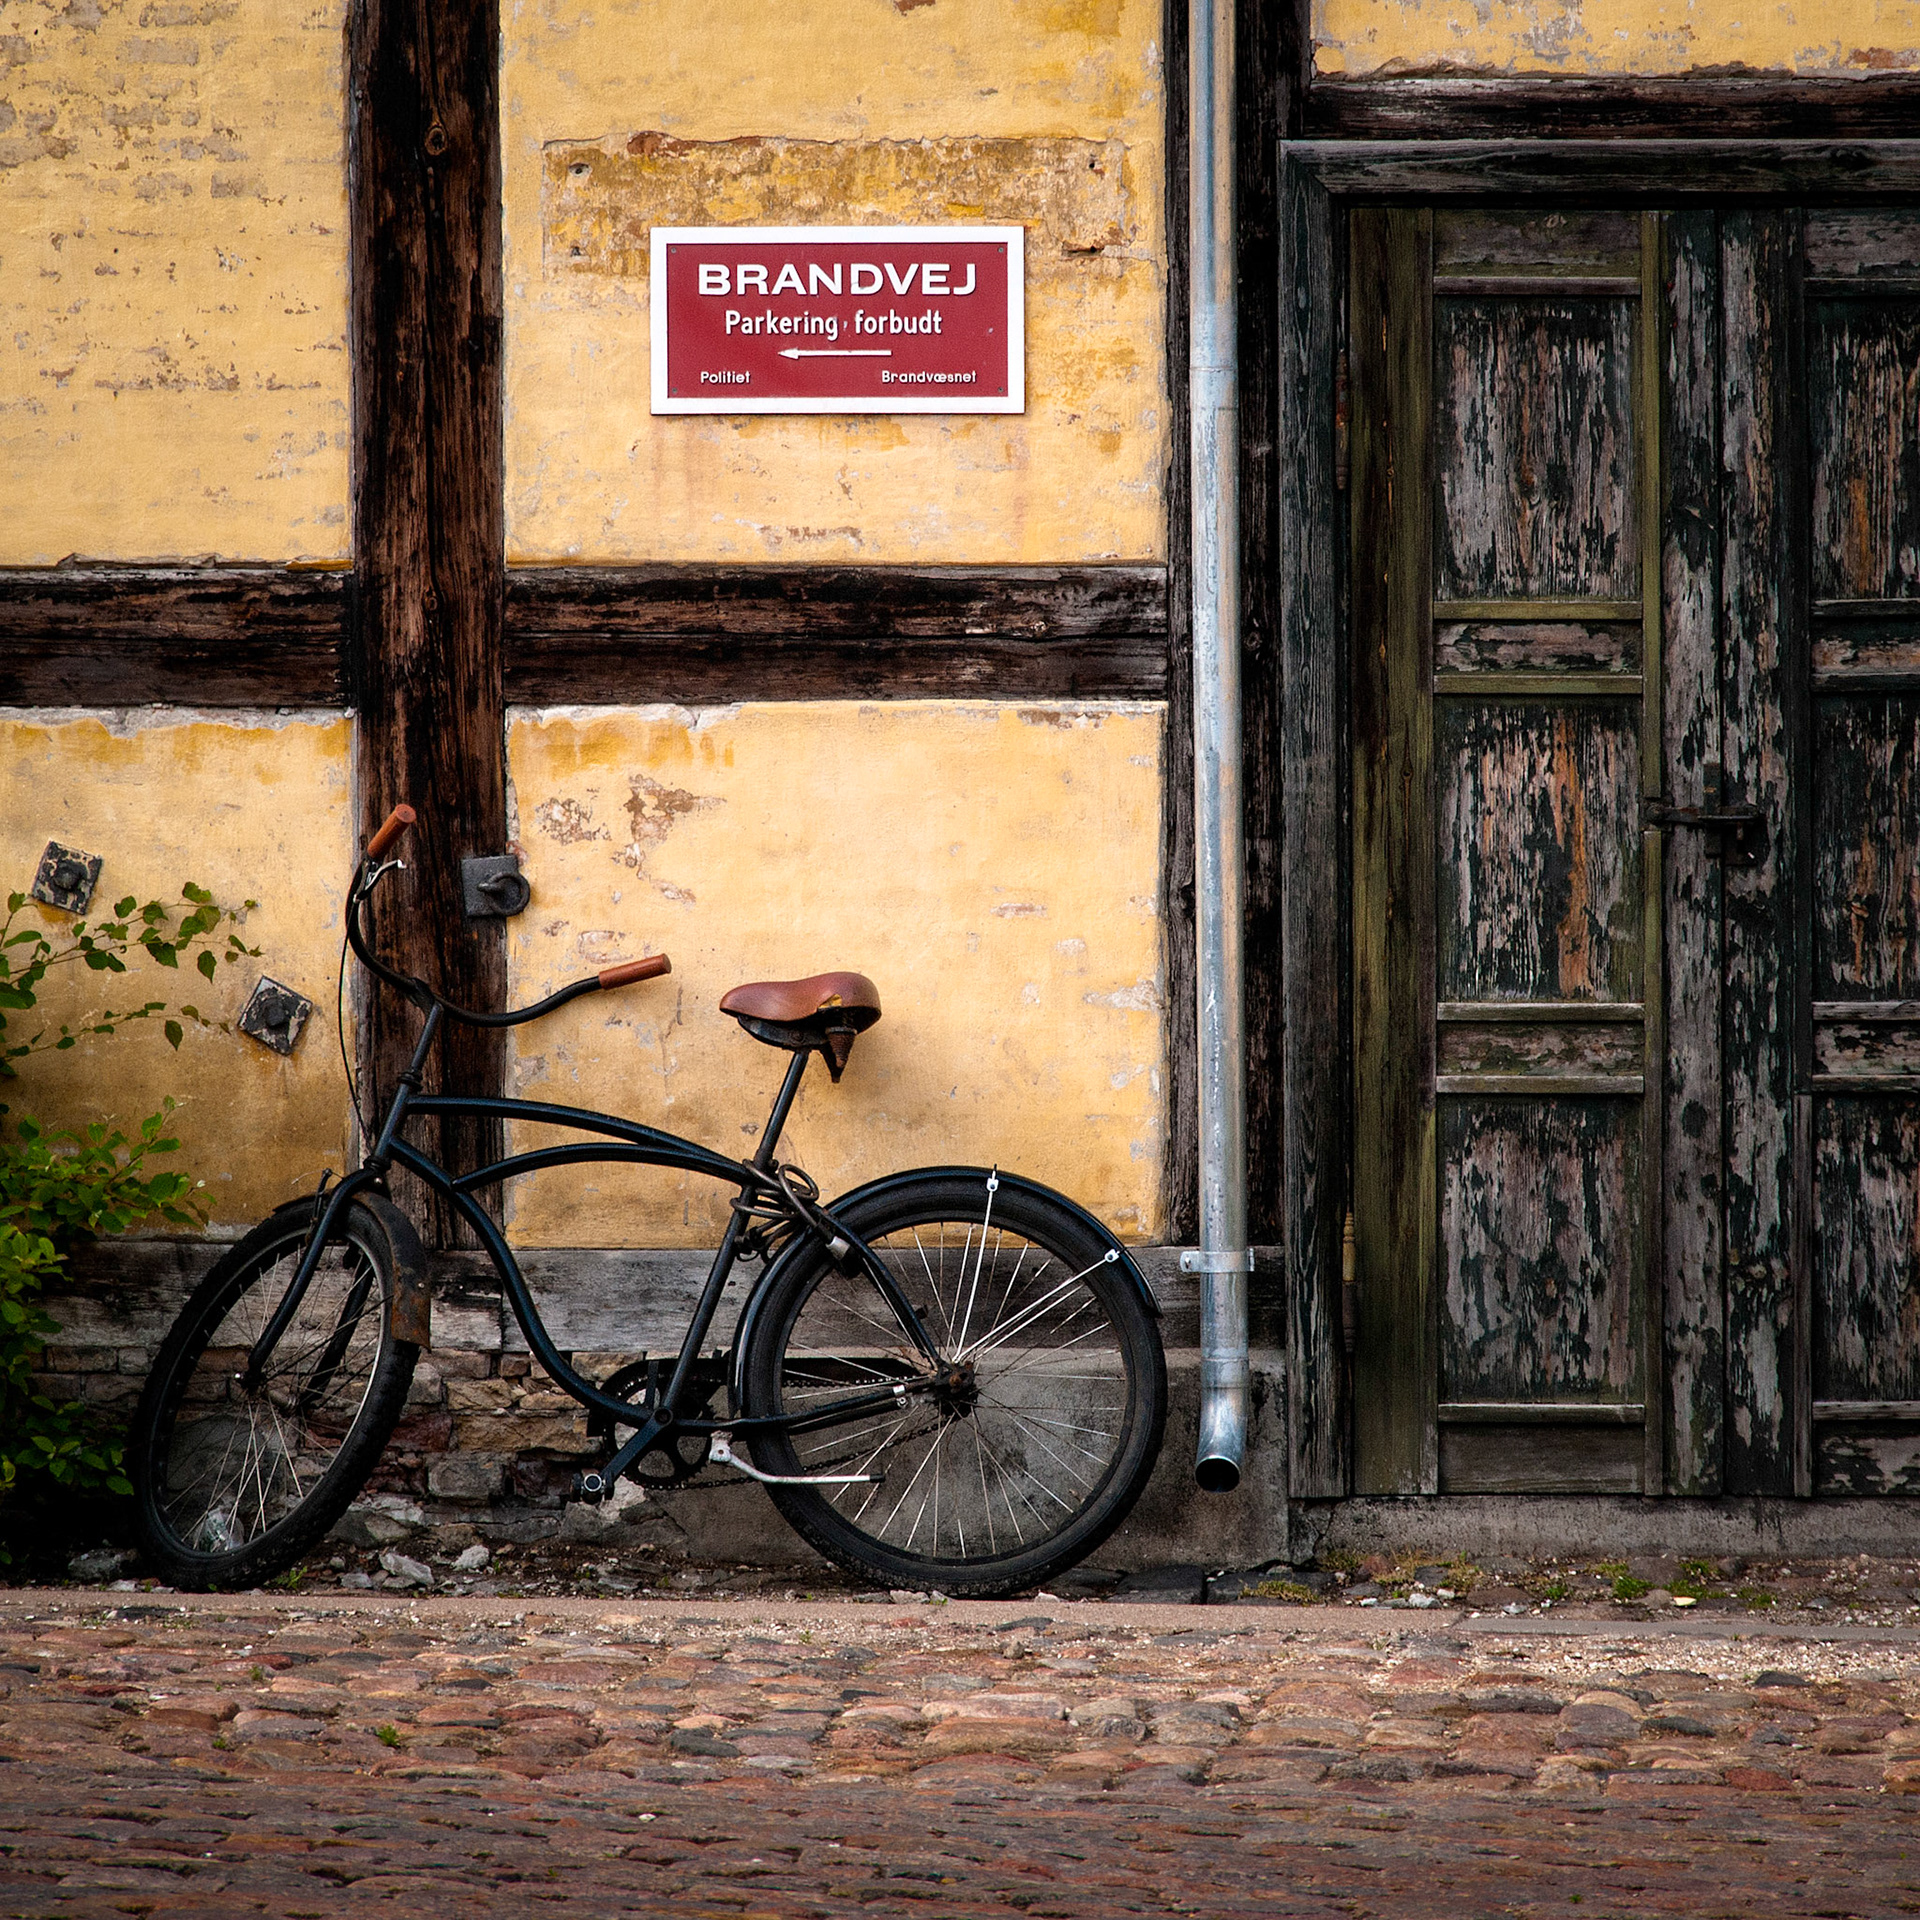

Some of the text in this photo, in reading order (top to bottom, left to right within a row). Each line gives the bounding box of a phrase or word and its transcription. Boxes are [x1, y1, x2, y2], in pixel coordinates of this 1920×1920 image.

[698, 263, 976, 296] BRANDVEJ
[725, 308, 943, 340] Parkering forbudt
[700, 370, 751, 384] Politiet
[881, 369, 977, 384] Brandvæsnet
